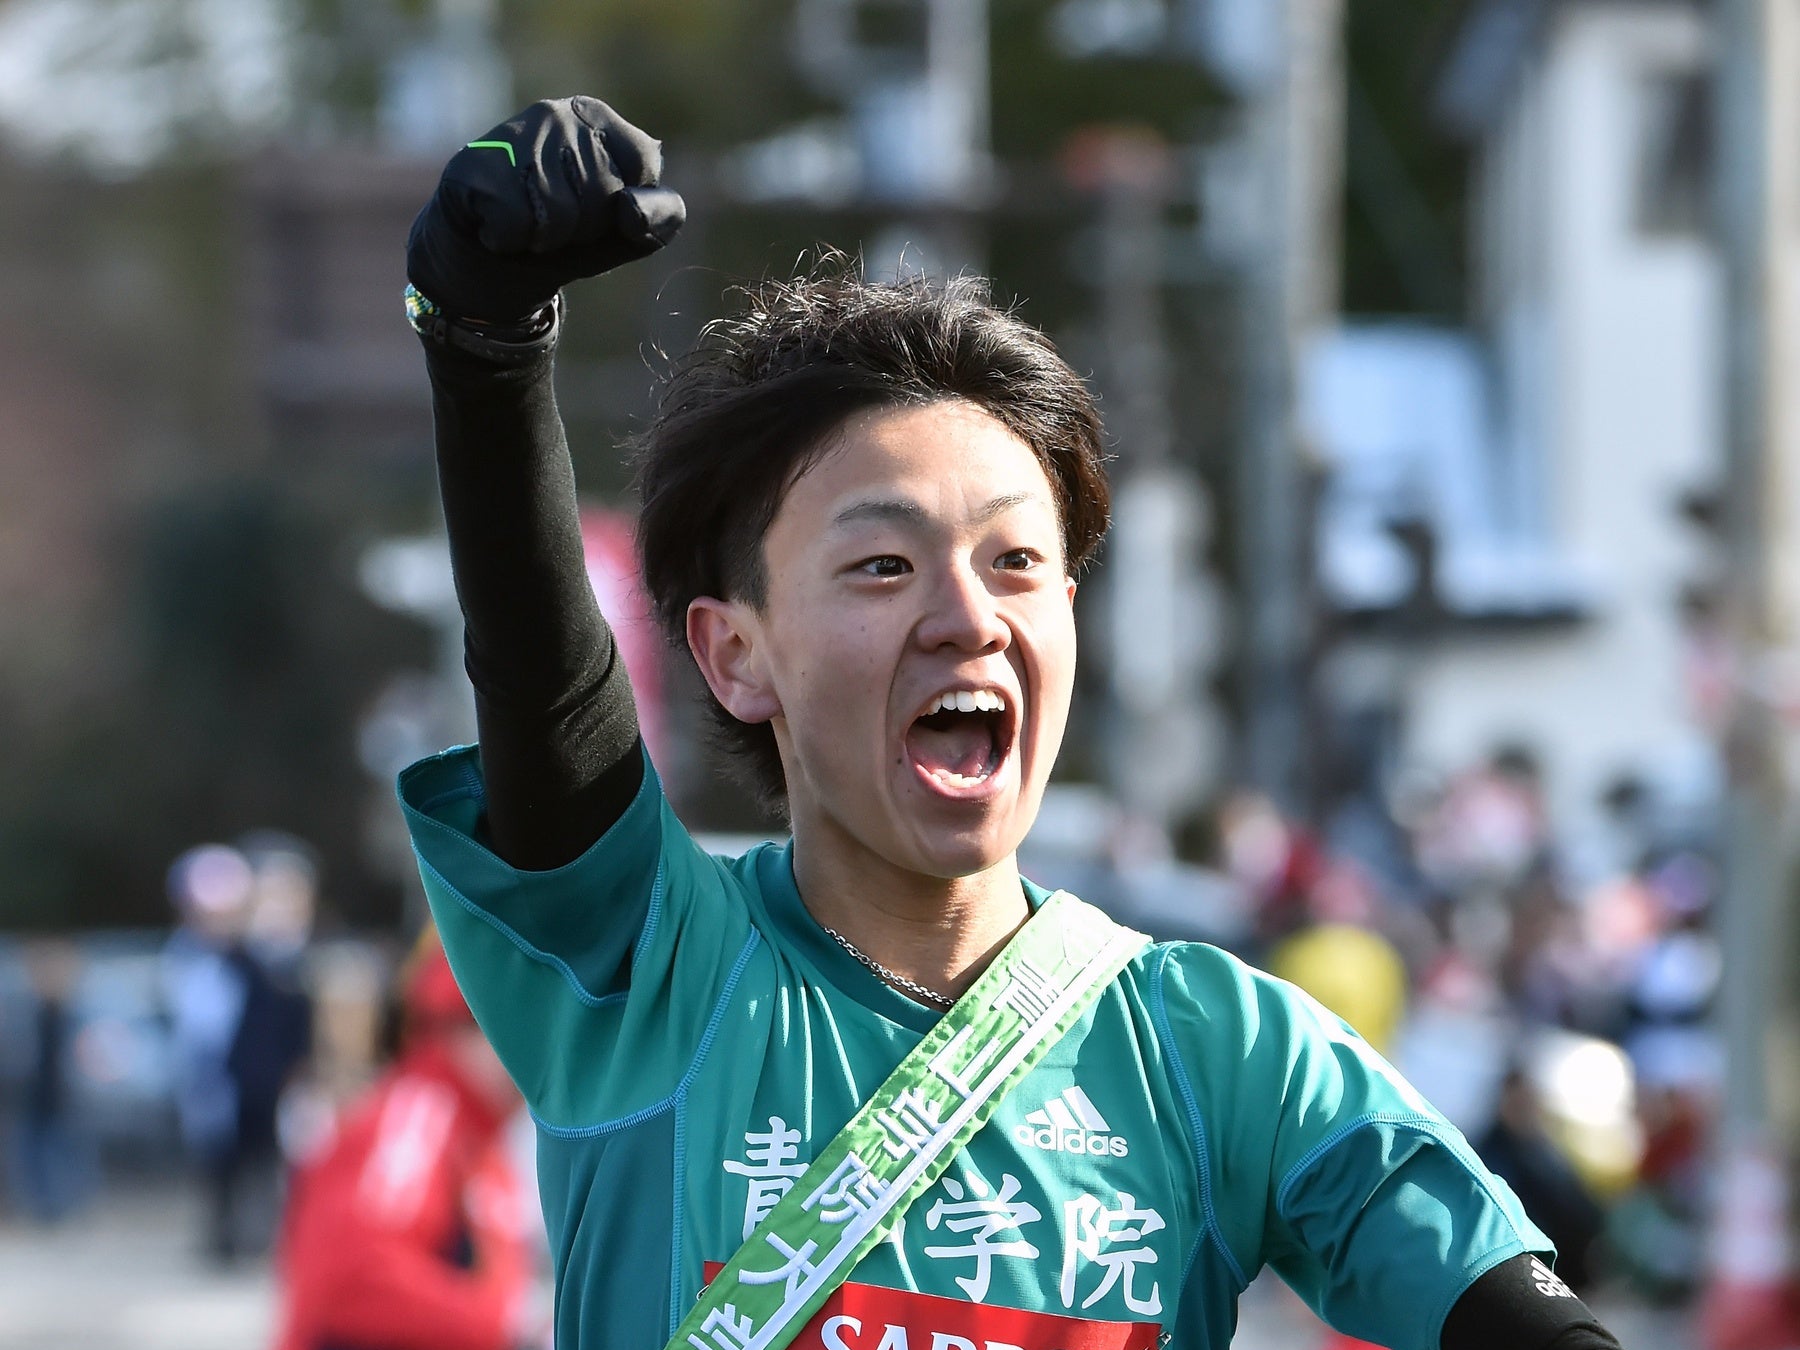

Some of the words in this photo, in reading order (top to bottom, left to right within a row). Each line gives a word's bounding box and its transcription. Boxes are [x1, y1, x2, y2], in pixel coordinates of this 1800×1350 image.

[1012, 1121, 1129, 1159] adidas
[722, 1115, 1166, 1316] 青学院
